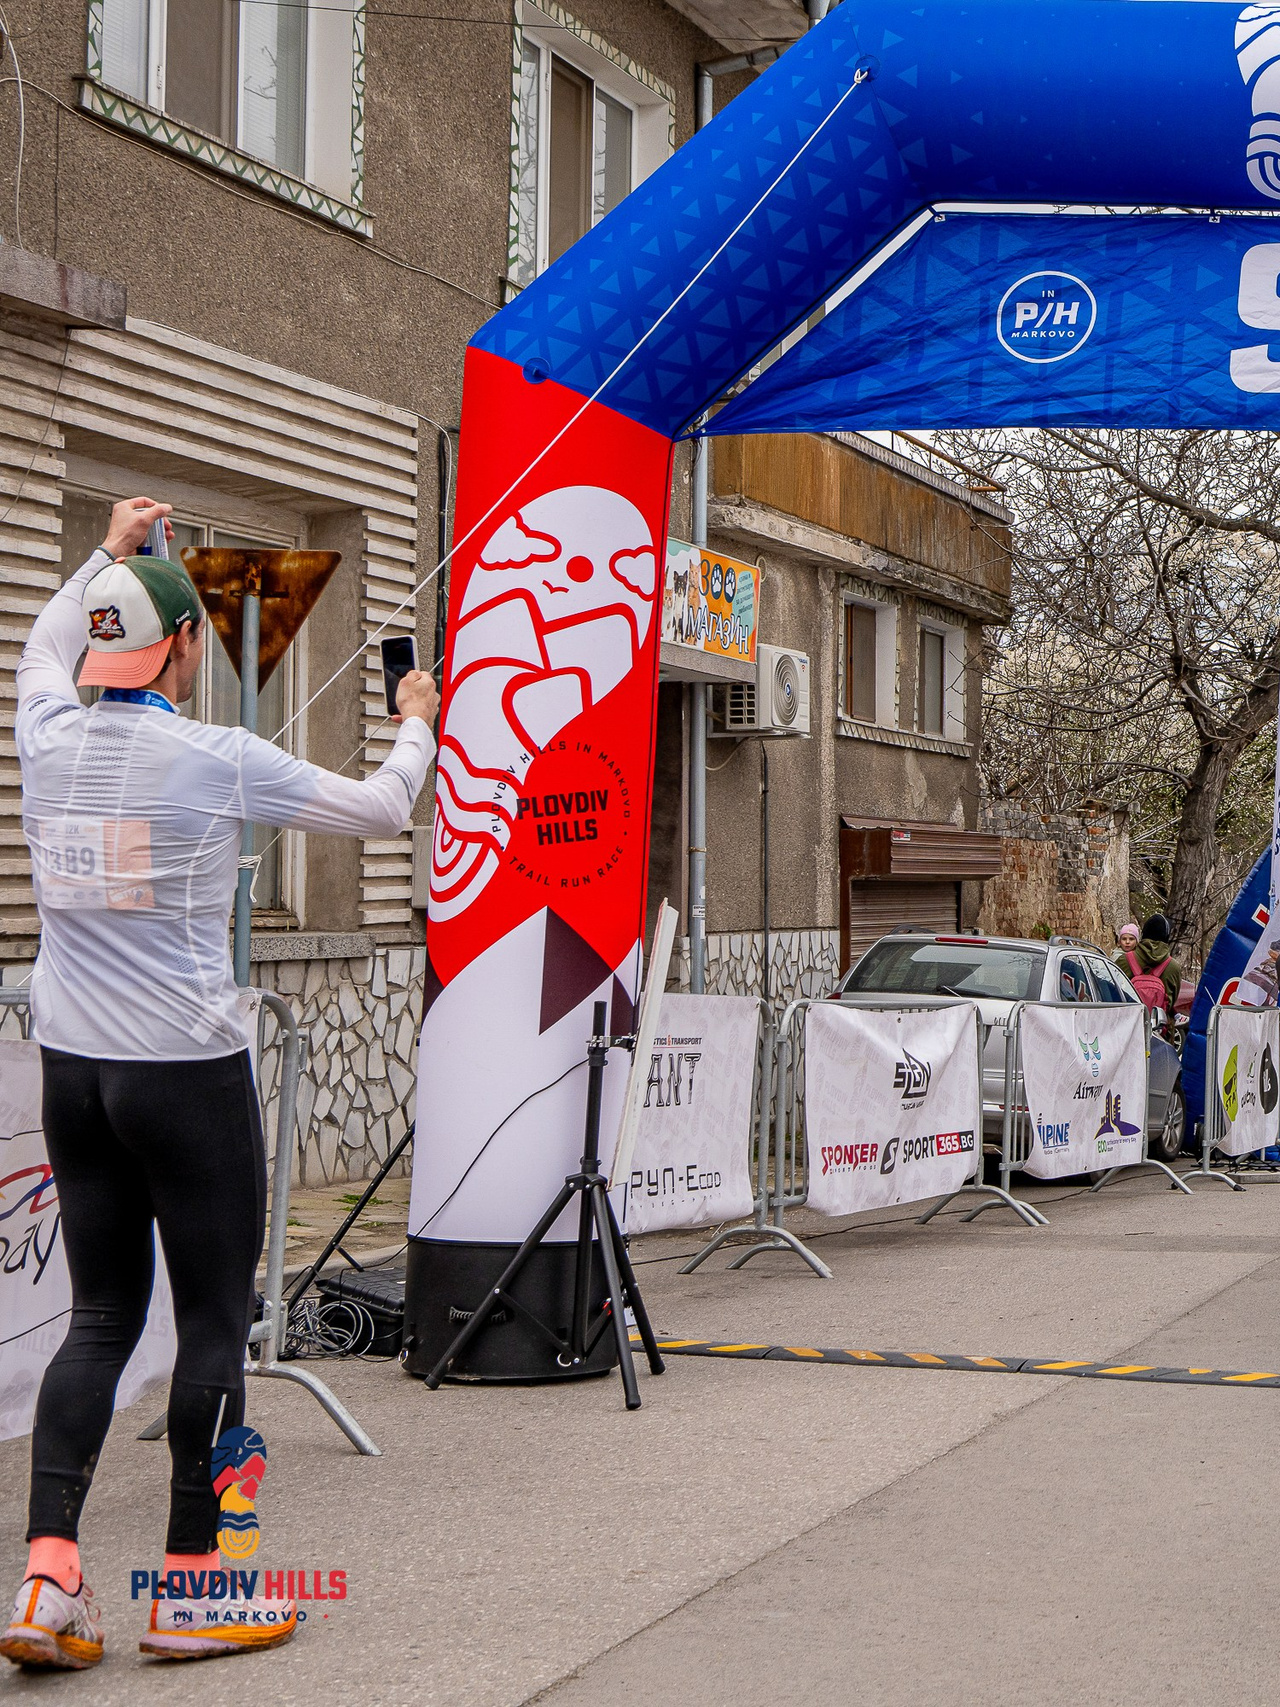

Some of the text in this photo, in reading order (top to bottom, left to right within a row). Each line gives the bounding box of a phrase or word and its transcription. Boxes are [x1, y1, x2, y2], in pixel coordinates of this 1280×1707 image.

[1041, 289, 1055, 298] IN
[1014, 301, 1080, 329] P/H
[1011, 330, 1076, 338] MARKOVO
[687, 604, 749, 655] МАГАЗИН
[491, 740, 631, 833] PLOVDIV HILLS IN MARKOVO
[516, 789, 609, 820] PLOVDIV
[536, 818, 598, 846] HILLS
[509, 846, 623, 888] TRAIL RUN RACE
[671, 1037, 702, 1046] TRANSPORT
[821, 1143, 879, 1176] SPONSER
